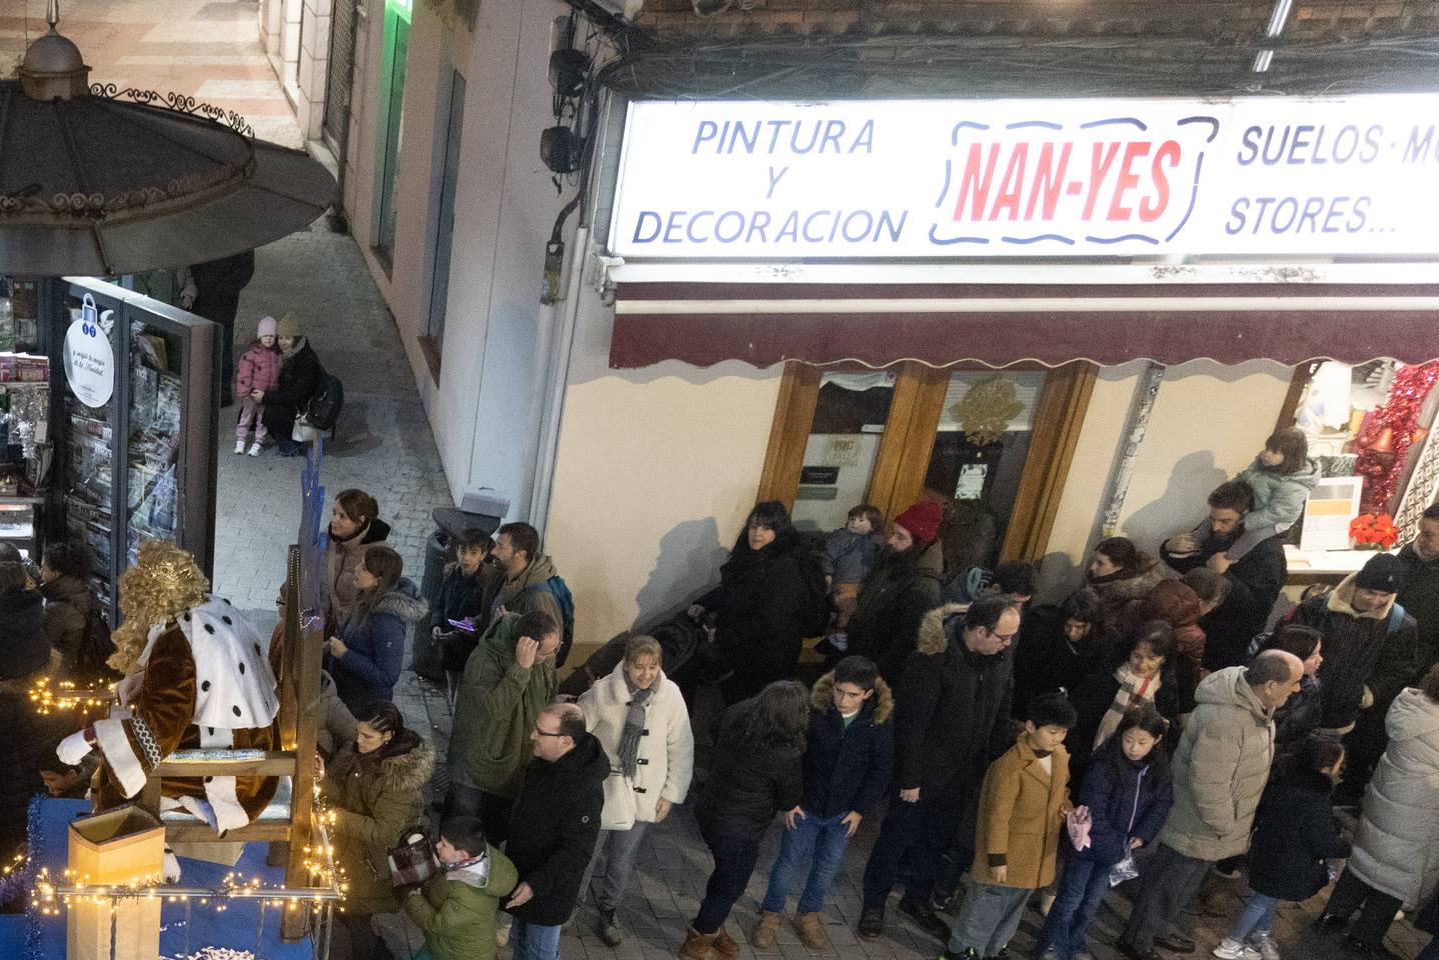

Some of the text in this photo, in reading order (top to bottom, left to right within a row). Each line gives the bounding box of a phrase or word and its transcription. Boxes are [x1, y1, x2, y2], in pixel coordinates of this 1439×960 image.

[691, 119, 875, 154] PINTURA
[1237, 124, 1384, 166] SUELOS
[765, 166, 790, 199] Y
[952, 139, 1182, 222] NAN-YES
[632, 210, 909, 244] DECORACION
[1225, 196, 1396, 235] STORES...
